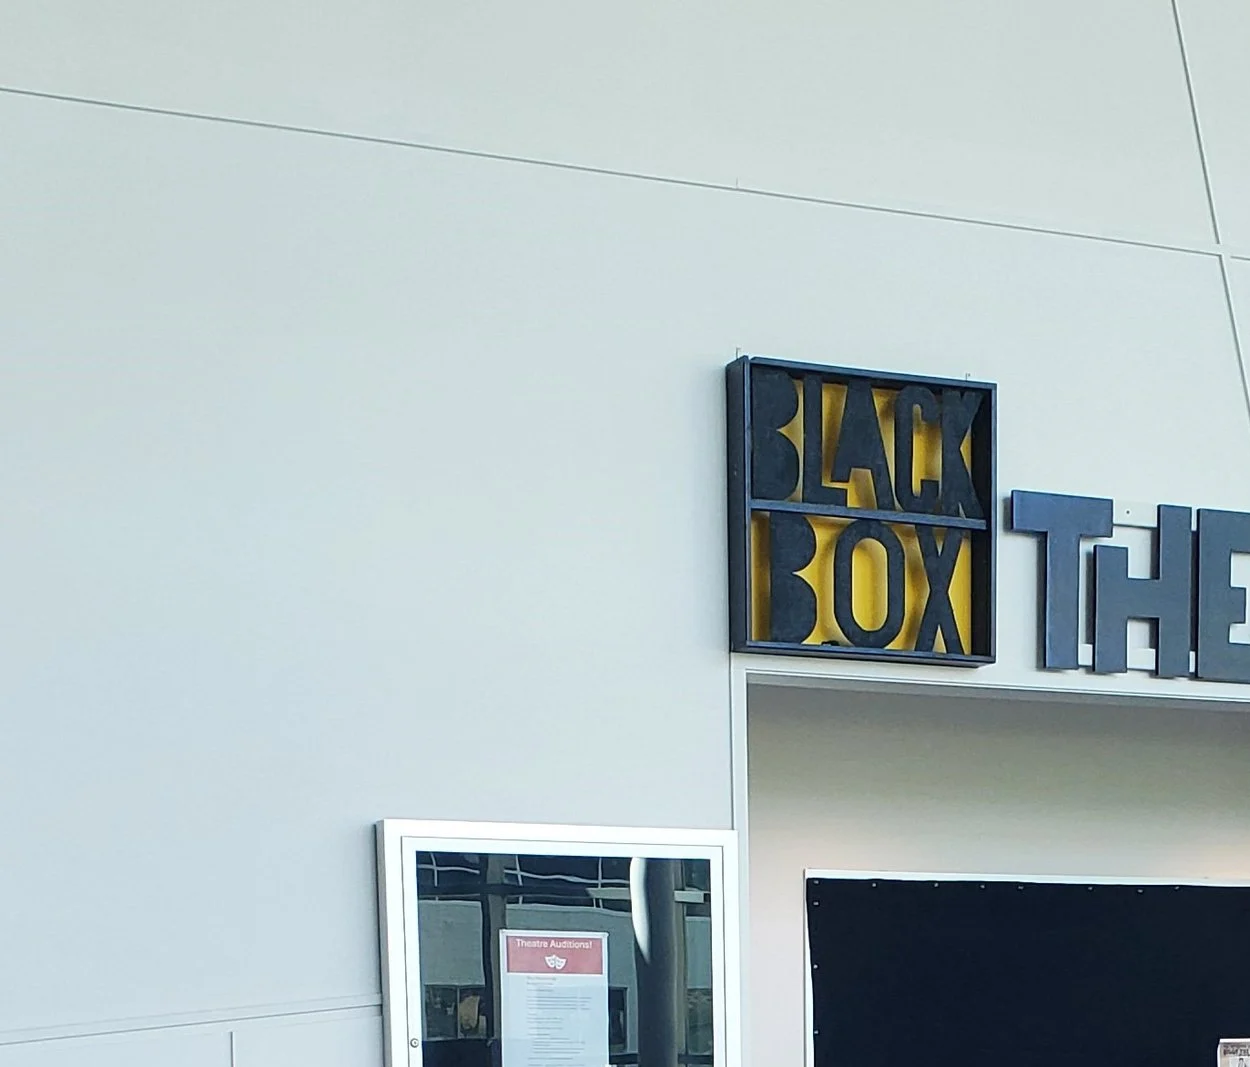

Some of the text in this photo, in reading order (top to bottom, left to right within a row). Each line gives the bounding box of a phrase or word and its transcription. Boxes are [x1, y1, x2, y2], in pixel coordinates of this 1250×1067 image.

[751, 365, 984, 519] BLACK
[769, 511, 969, 655] BOX
[516, 938, 593, 949] Theatre Auditions!
